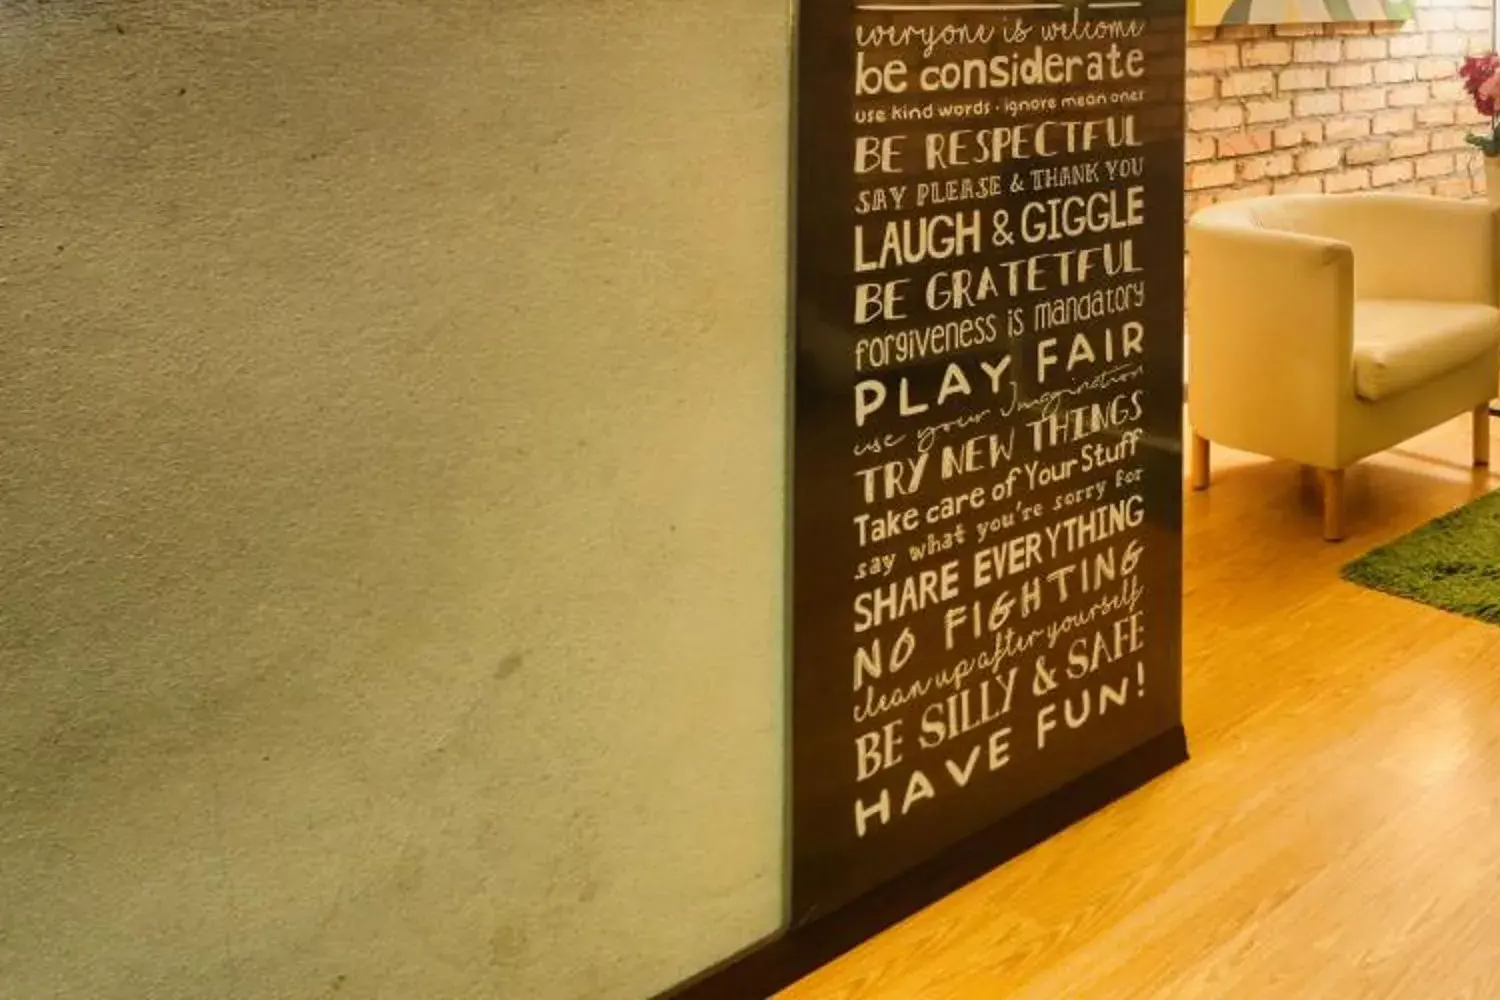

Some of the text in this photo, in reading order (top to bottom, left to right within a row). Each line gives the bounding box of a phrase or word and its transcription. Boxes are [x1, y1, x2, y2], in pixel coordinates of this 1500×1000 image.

[854, 42, 1145, 96] be considerate
[855, 7, 1145, 57] everyone is welcome
[854, 114, 1144, 175] BE RESPECTFUL
[855, 89, 1145, 125] use kind words ignore mean ones
[854, 157, 1145, 215] SAY PLEASE & THANK YOU
[854, 185, 1145, 274] LAUGH & GIGGLE
[854, 278, 912, 325] BE
[855, 279, 1146, 372] forgiveness is mandatory
[854, 321, 1145, 428] PLAY FAIR
[853, 433, 907, 457] use
[916, 408, 992, 452] your
[853, 389, 1145, 504] TRY NEW THINGS
[853, 427, 1145, 548] Take care of Your Stuff
[854, 468, 1145, 581] say what you're sorry for
[853, 494, 1145, 634] SHARE EVERYTHING
[853, 539, 1146, 693] NO FIGHTING
[853, 575, 1146, 723] clean up after yourself
[854, 609, 1146, 783] BE SILLY & SAFE
[854, 660, 1146, 838] HAVE FUN!
